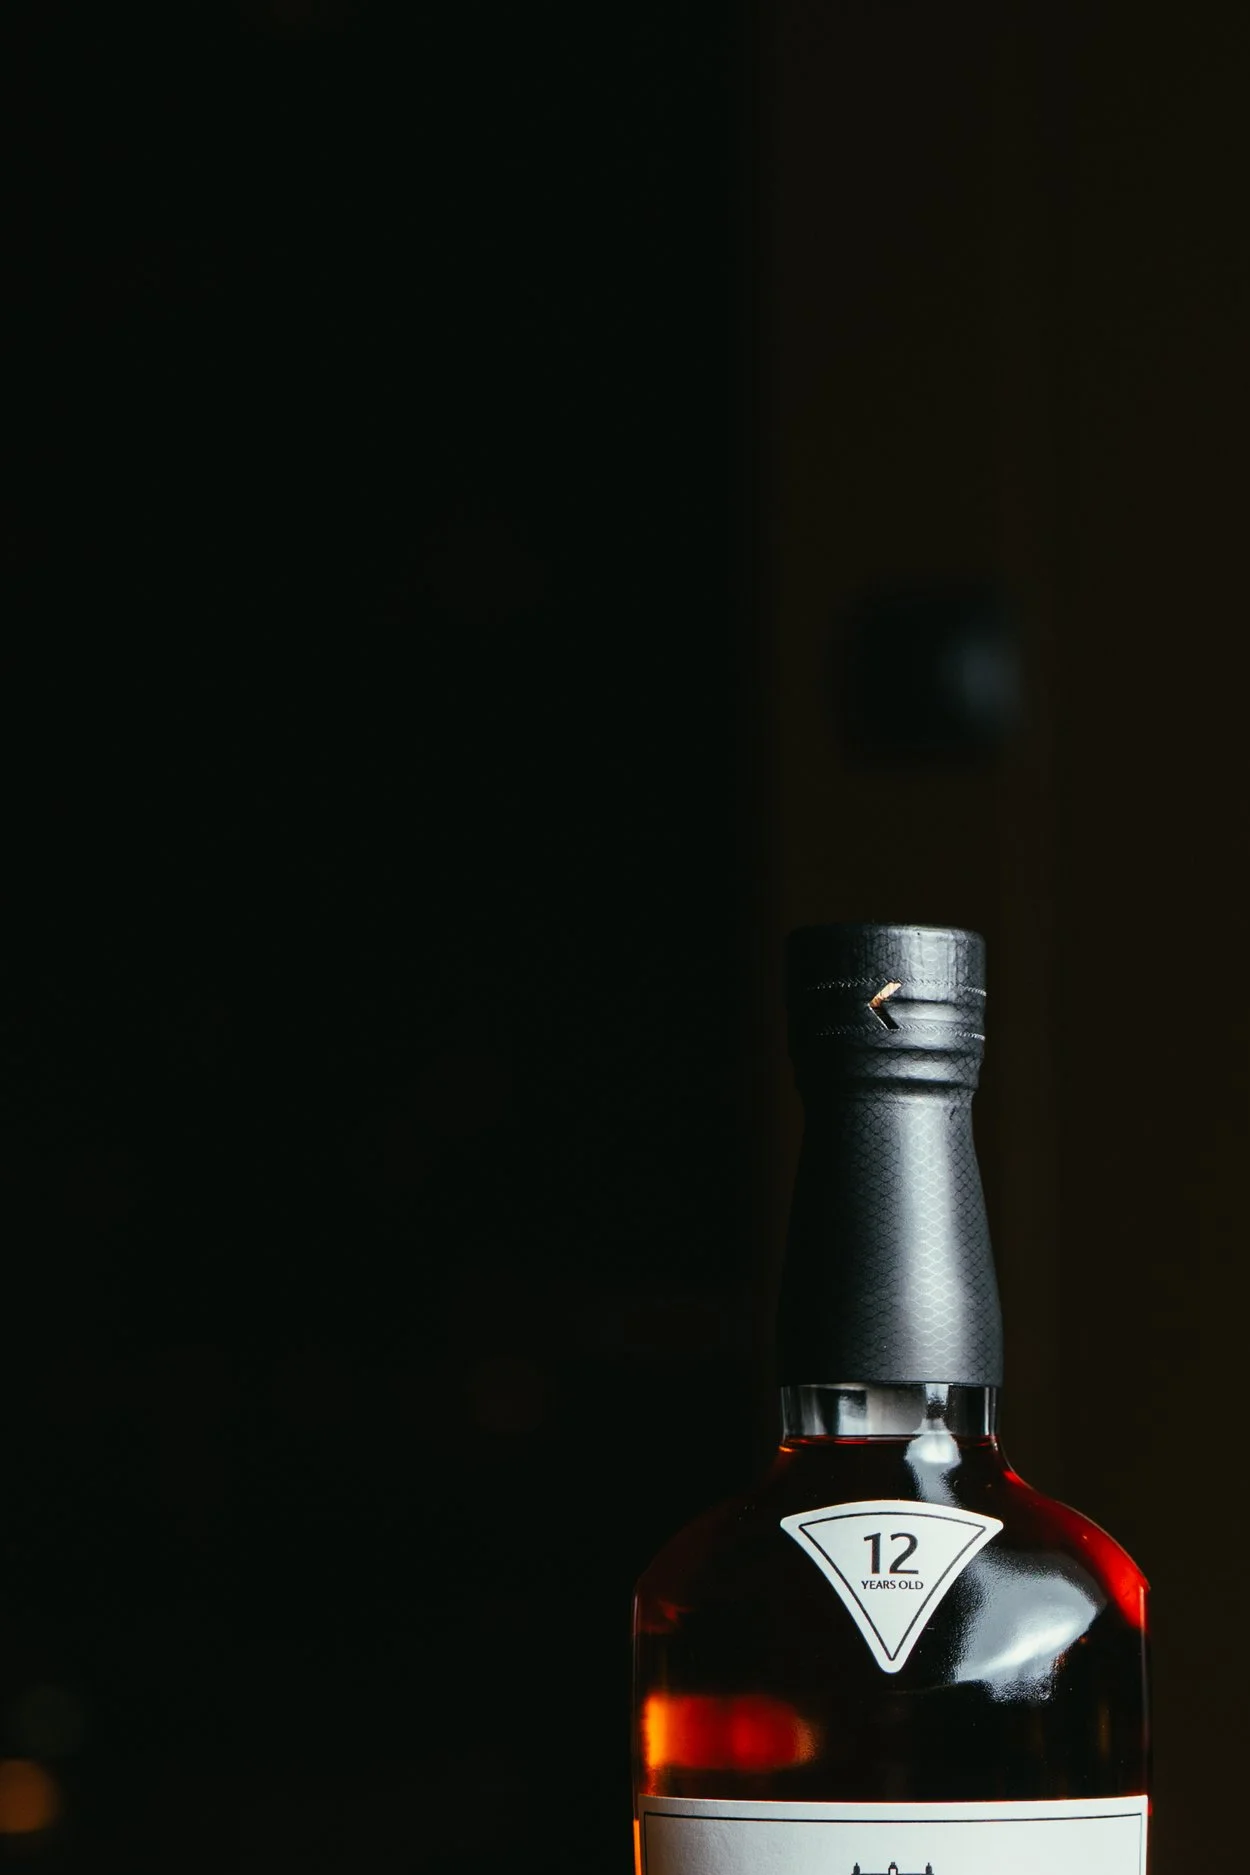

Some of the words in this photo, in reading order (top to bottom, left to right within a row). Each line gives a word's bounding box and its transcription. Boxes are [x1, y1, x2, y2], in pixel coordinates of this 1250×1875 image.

[864, 1533, 919, 1574] 12
[861, 1580, 896, 1589] YEARS
[899, 1580, 924, 1589] OLD
